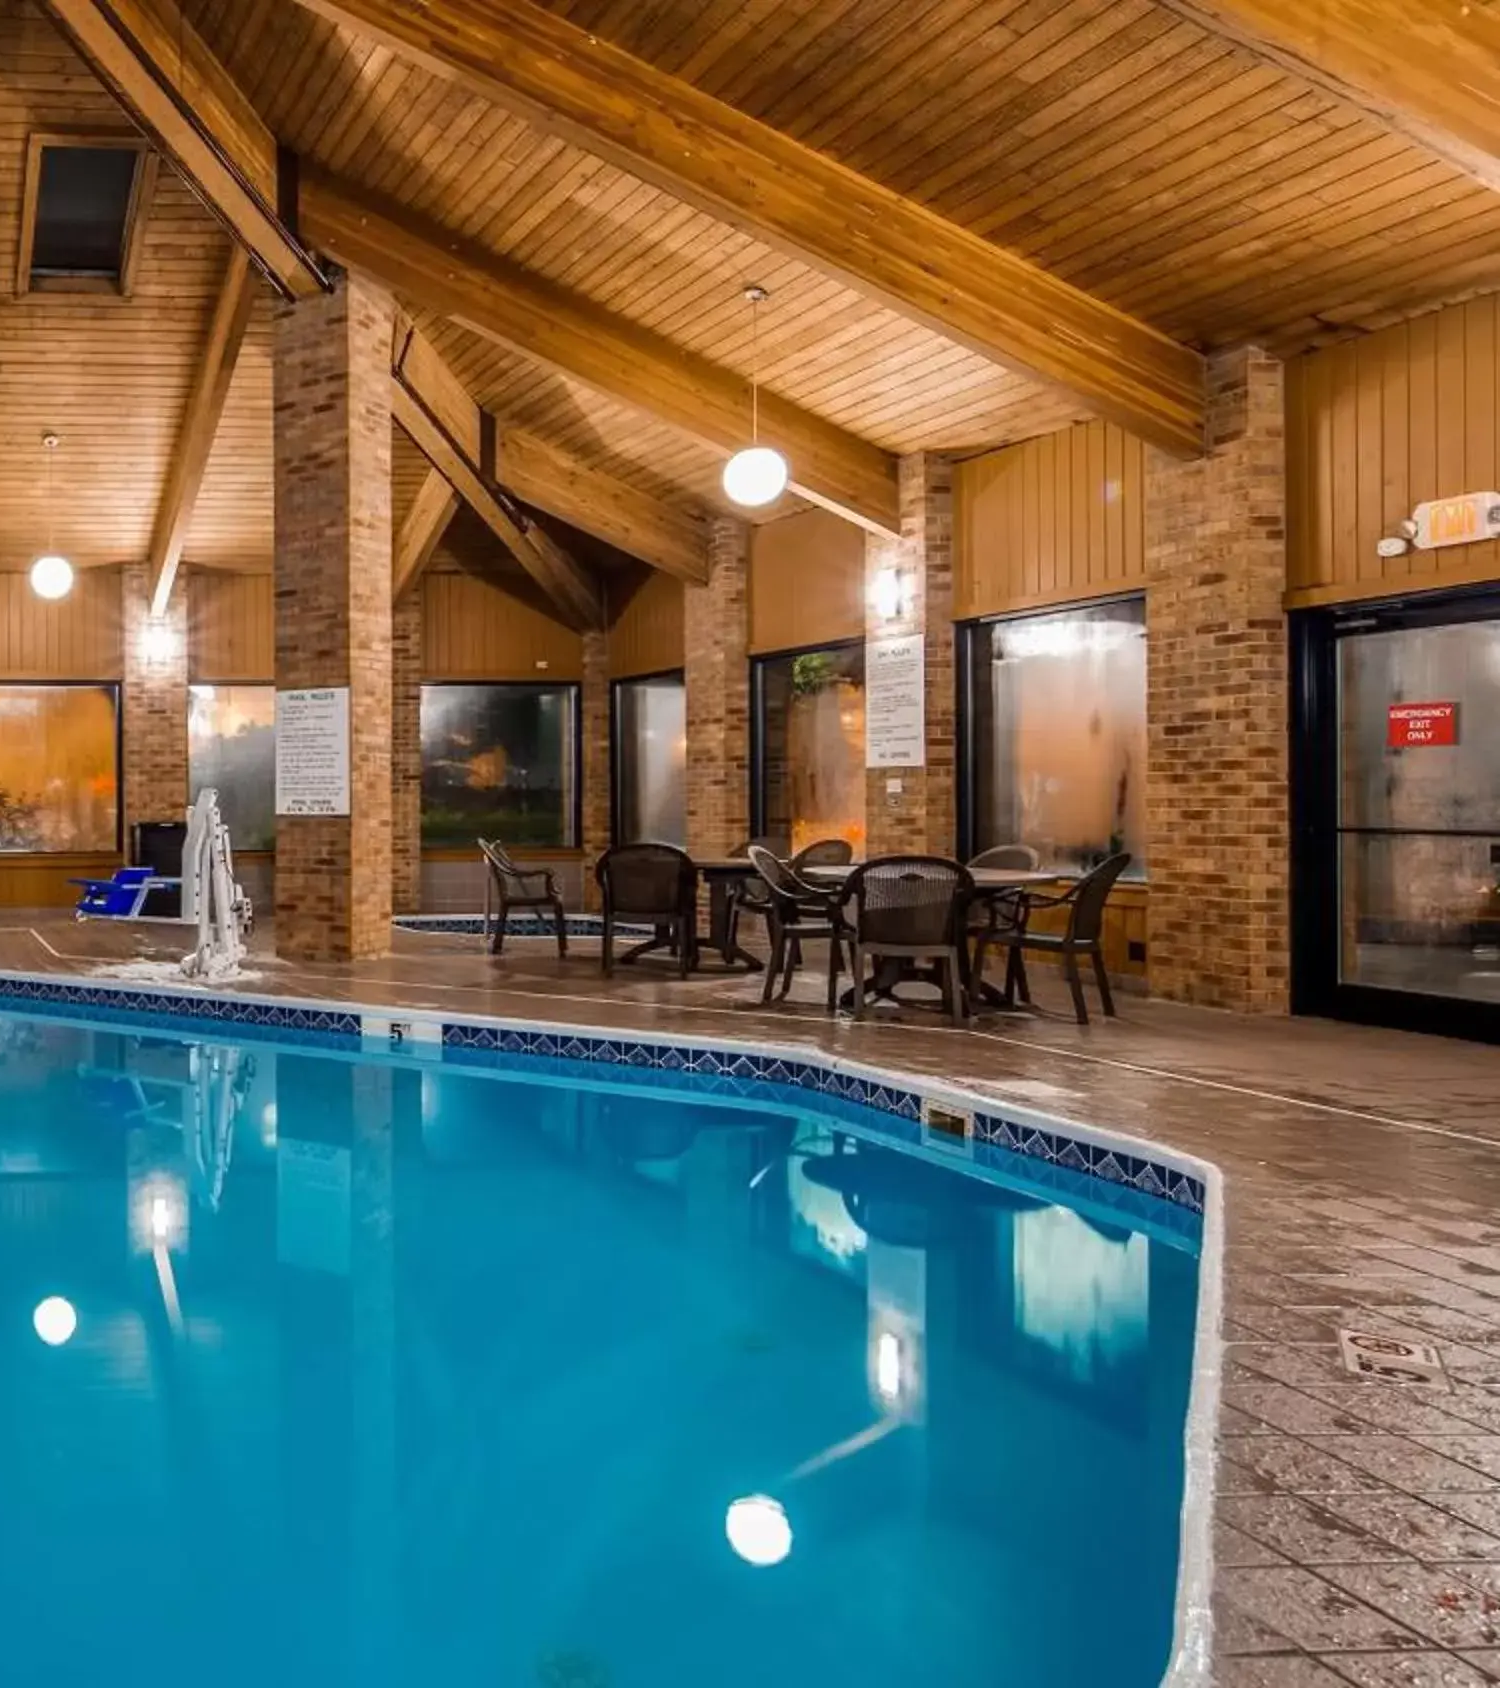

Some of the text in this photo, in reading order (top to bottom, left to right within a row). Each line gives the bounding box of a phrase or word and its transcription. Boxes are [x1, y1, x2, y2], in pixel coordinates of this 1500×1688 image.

[1390, 708, 1452, 718] EMERGENCY
[1409, 719, 1431, 729] EXIT
[1407, 731, 1433, 741] ONLY
